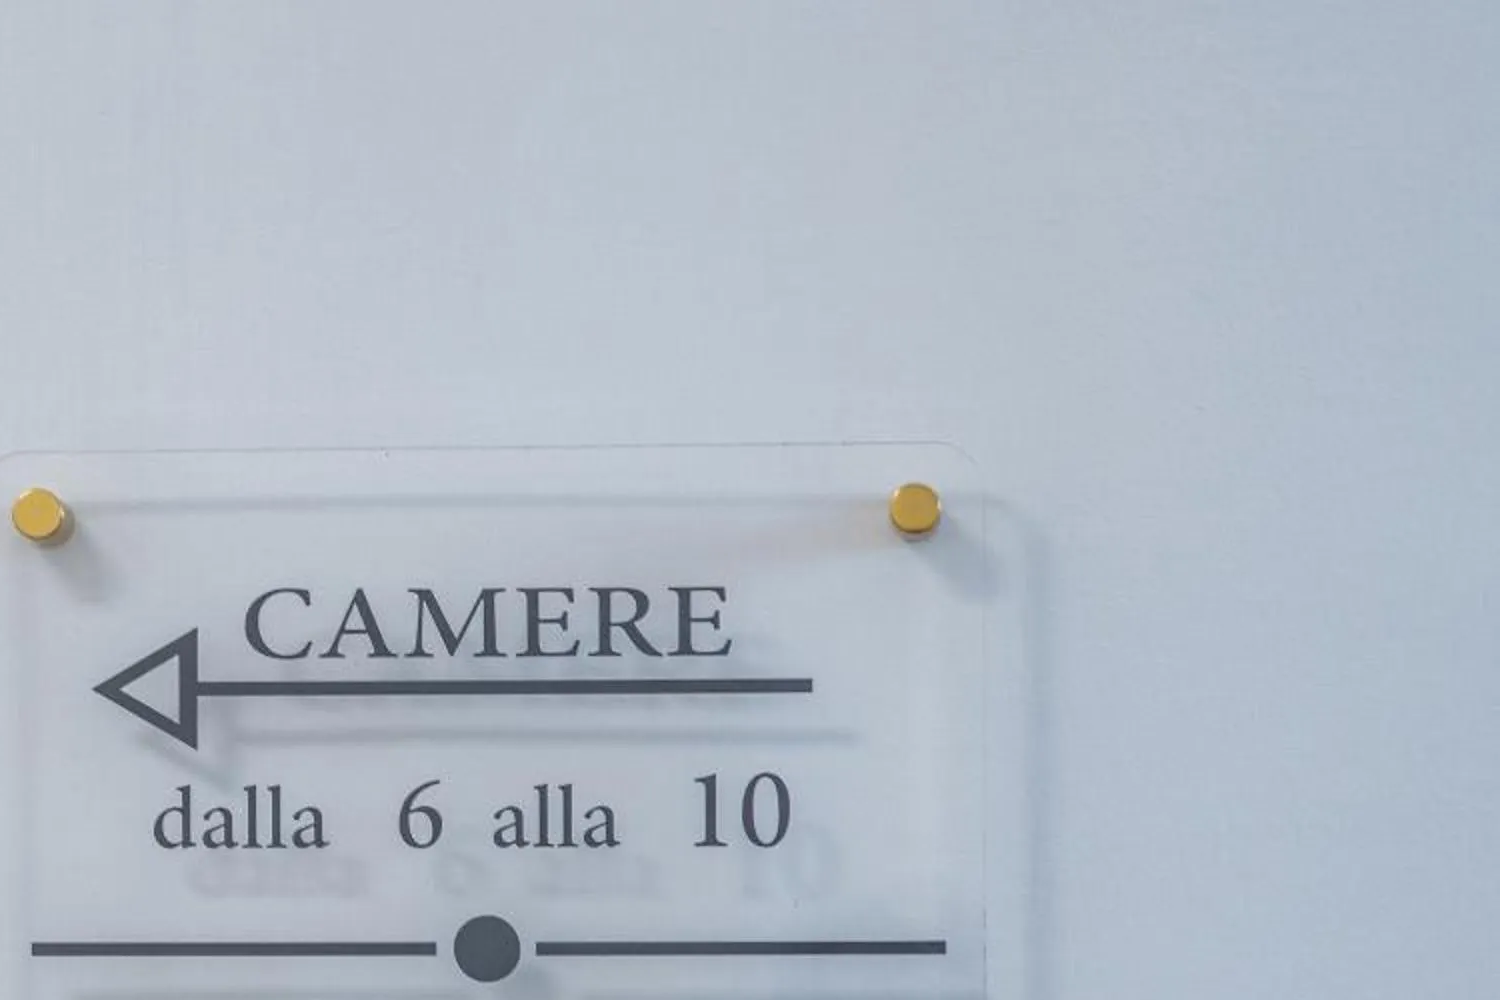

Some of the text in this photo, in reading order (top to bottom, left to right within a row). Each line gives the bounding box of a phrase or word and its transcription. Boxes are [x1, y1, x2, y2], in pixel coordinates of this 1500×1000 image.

[244, 586, 733, 660] CAMERE
[153, 772, 791, 849] dalla 6 alla 10
